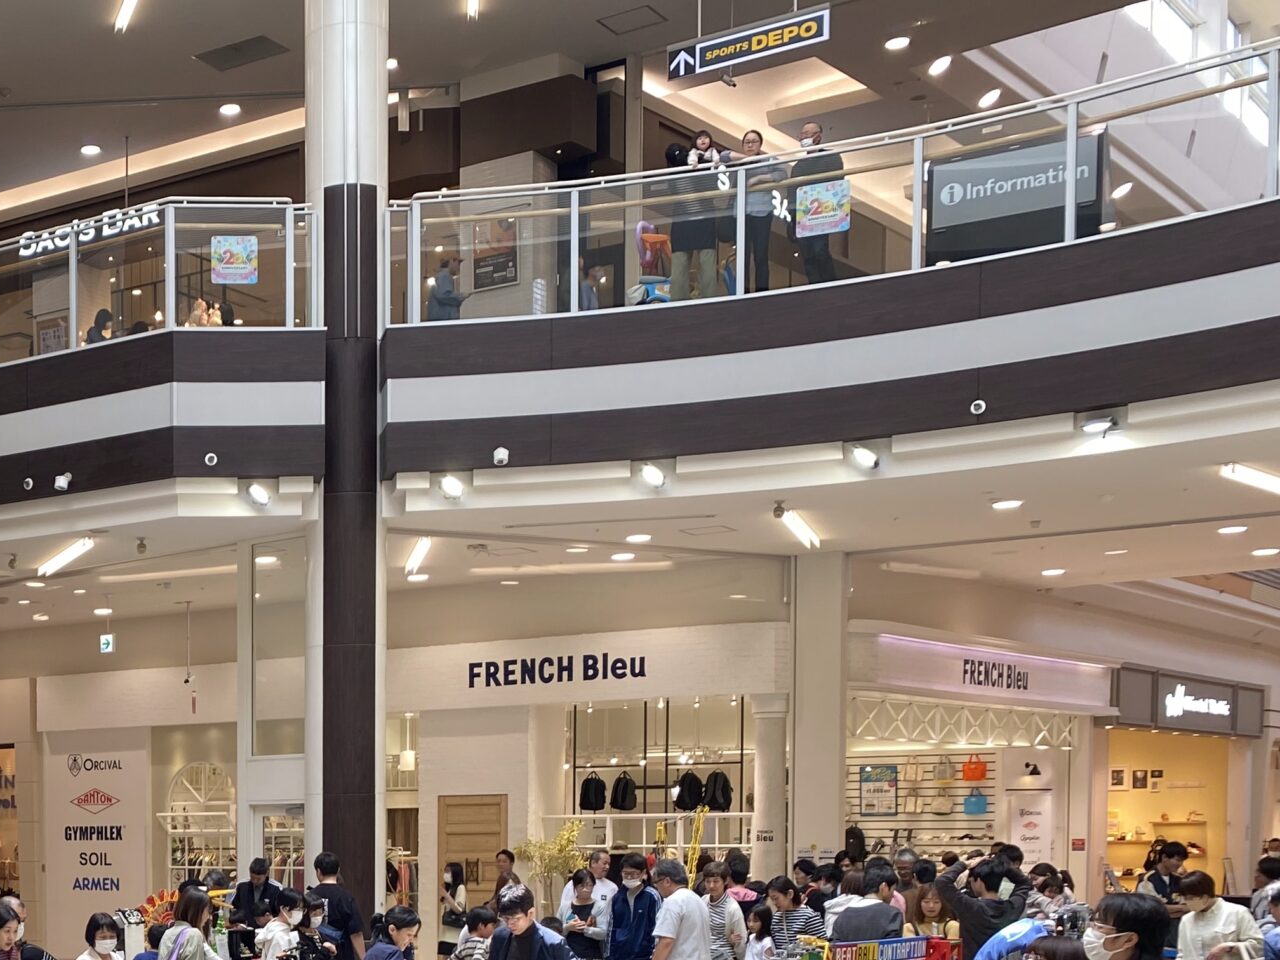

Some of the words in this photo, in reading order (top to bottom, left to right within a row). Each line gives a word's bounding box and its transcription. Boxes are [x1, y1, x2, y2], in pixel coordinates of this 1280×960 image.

[705, 41, 749, 60] SPORTS
[751, 20, 818, 51] DEPO
[468, 656, 574, 688] FRENCH
[582, 652, 647, 681] Bleu
[963, 659, 1004, 688] FRENCH
[1006, 664, 1029, 690] Bleu
[77, 789, 112, 804] DANTON
[64, 826, 123, 841] GYMPHLEX
[79, 852, 112, 866] SOIL
[73, 877, 120, 891] ARMEN
